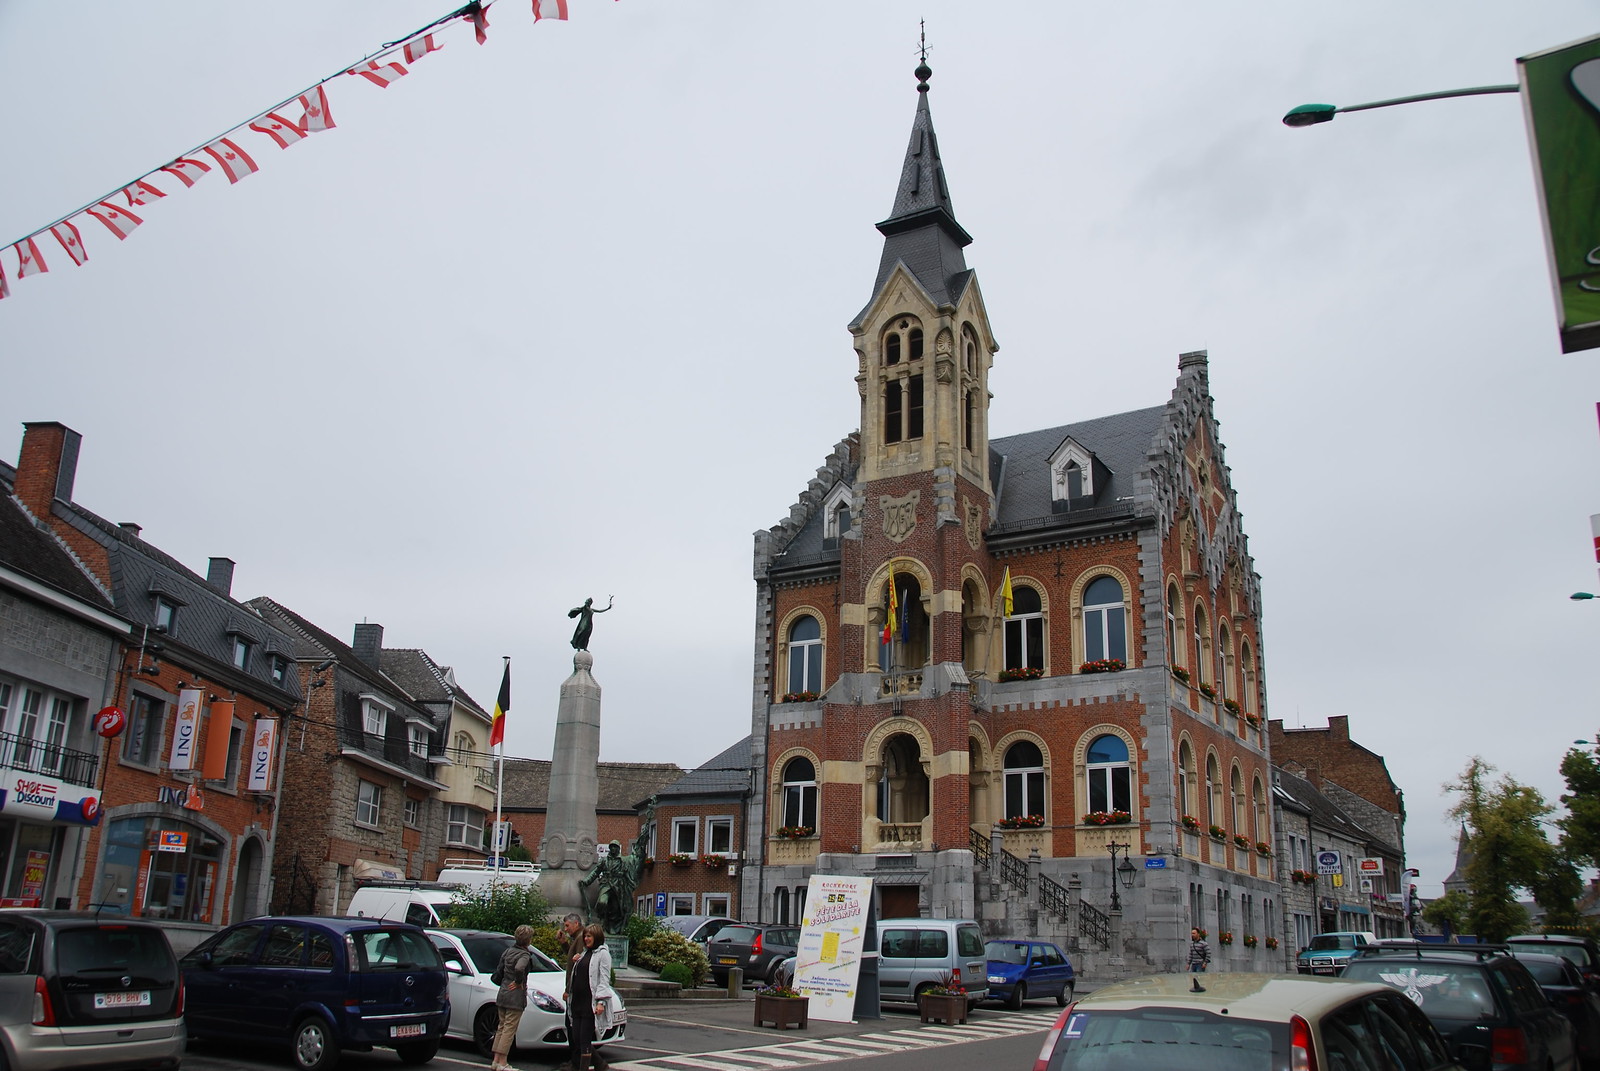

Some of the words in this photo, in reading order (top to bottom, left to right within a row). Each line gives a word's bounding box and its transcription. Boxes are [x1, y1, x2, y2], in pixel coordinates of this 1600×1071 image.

[177, 725, 192, 758] ING
[255, 751, 268, 780] ING
[15, 779, 41, 794] SHOE
[158, 785, 187, 808] ING
[658, 896, 664, 907] P
[837, 903, 847, 911] DE
